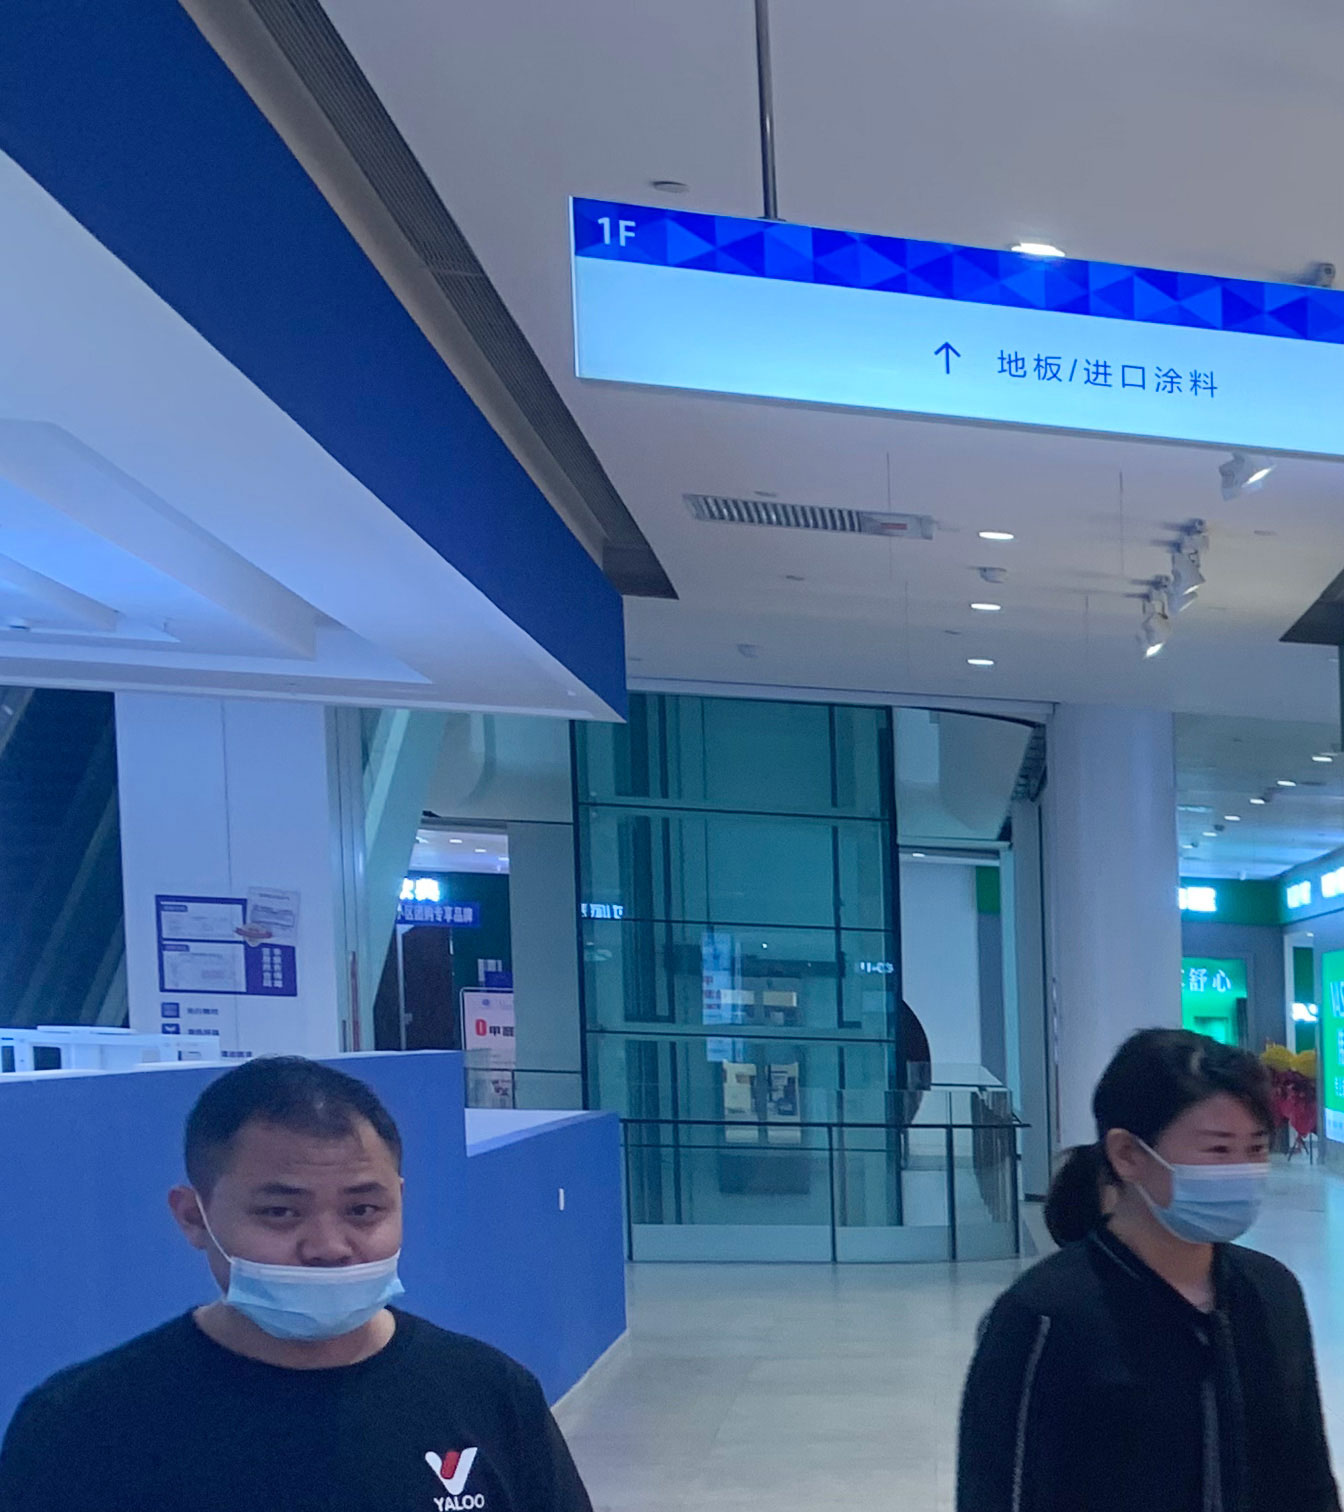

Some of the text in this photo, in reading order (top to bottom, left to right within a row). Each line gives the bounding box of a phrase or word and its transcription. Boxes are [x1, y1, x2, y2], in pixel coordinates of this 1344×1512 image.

[595, 217, 637, 249] 1F
[997, 348, 1220, 401] 地板/进口涂料
[1180, 967, 1232, 993] 舒心
[432, 1493, 485, 1512] YALOO
